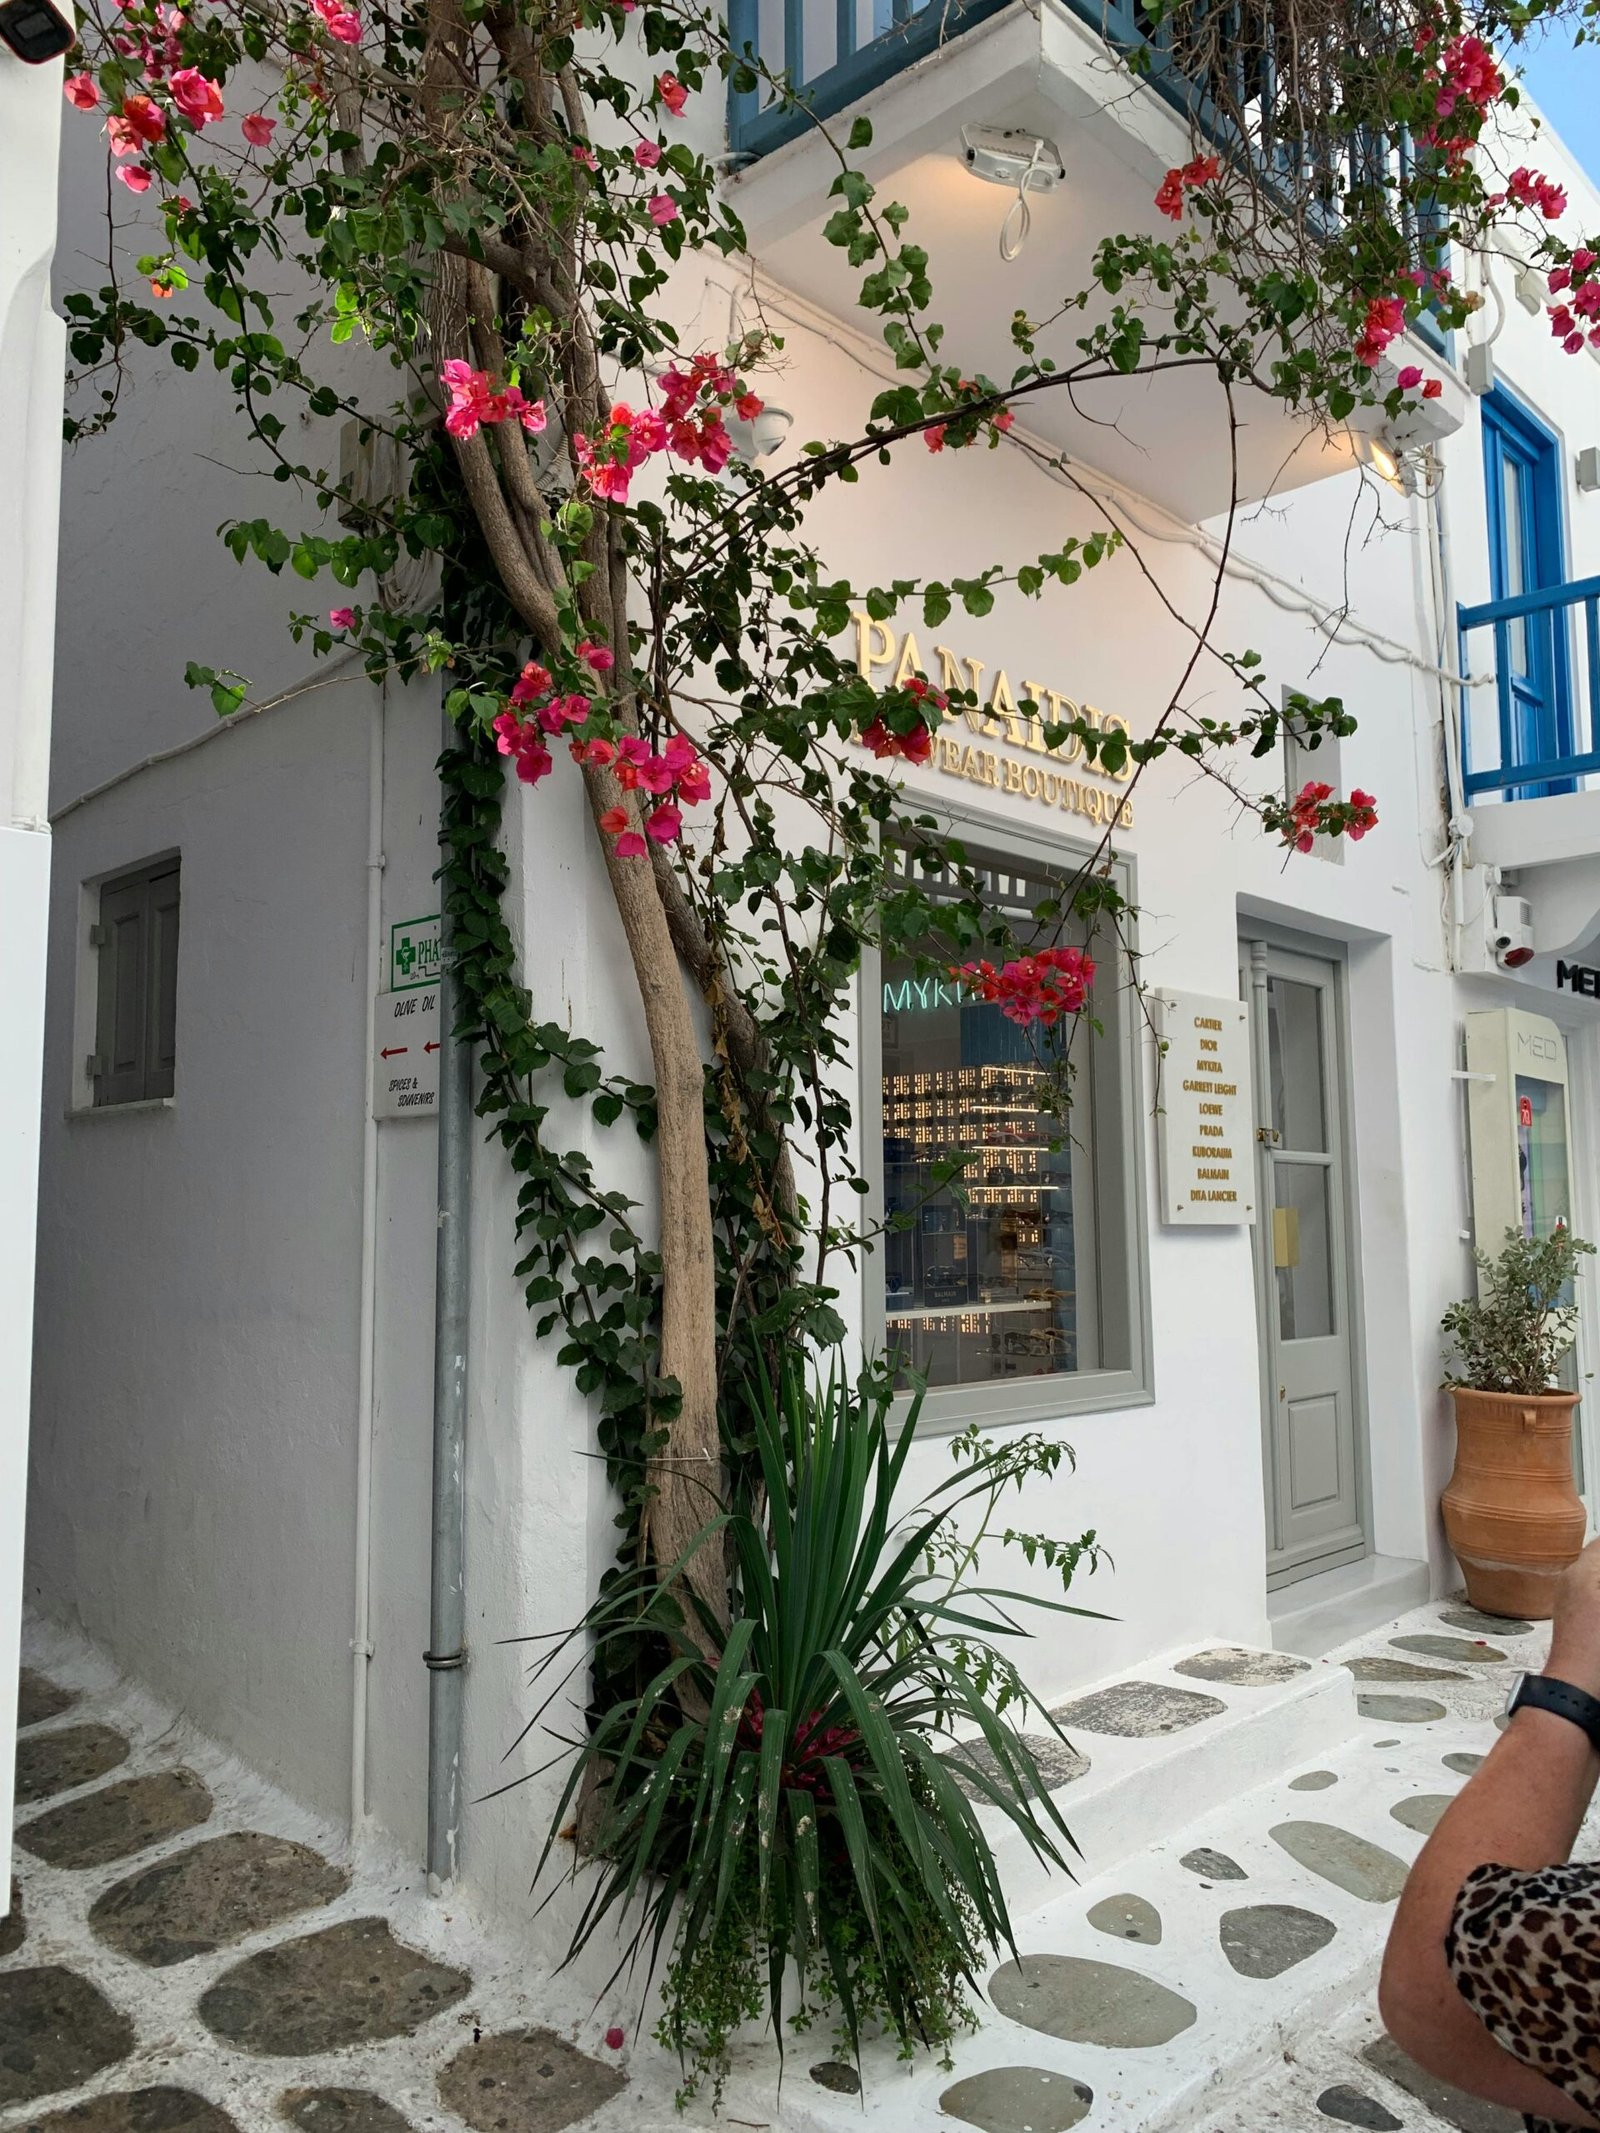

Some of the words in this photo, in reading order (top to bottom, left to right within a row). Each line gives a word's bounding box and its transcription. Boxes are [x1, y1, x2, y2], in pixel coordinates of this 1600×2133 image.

[851, 610, 1134, 782] PANAIDIS
[1001, 757, 1134, 829] BOUTIQUE
[418, 938, 441, 965] PHA
[883, 977, 986, 1013] MYKI
[394, 998, 418, 1018] OLIVE
[422, 994, 436, 1012] OIL
[1194, 1016, 1223, 1032] CARTIER
[1200, 1038, 1218, 1052] DIOR
[1517, 1031, 1557, 1062] MED
[1196, 1059, 1223, 1074] MYKITA
[388, 1077, 411, 1092] SPICES
[412, 1077, 418, 1089] &
[1182, 1079, 1213, 1094] GARRETT
[1214, 1083, 1237, 1096] LEIGHT
[397, 1091, 434, 1107] SOUVENIRS
[1199, 1103, 1223, 1116] LOEWE
[1199, 1124, 1224, 1138] PRADA
[1197, 1167, 1230, 1181] BALMAIN
[1190, 1189, 1207, 1202] DITA
[1208, 1190, 1237, 1203] LANCIER
